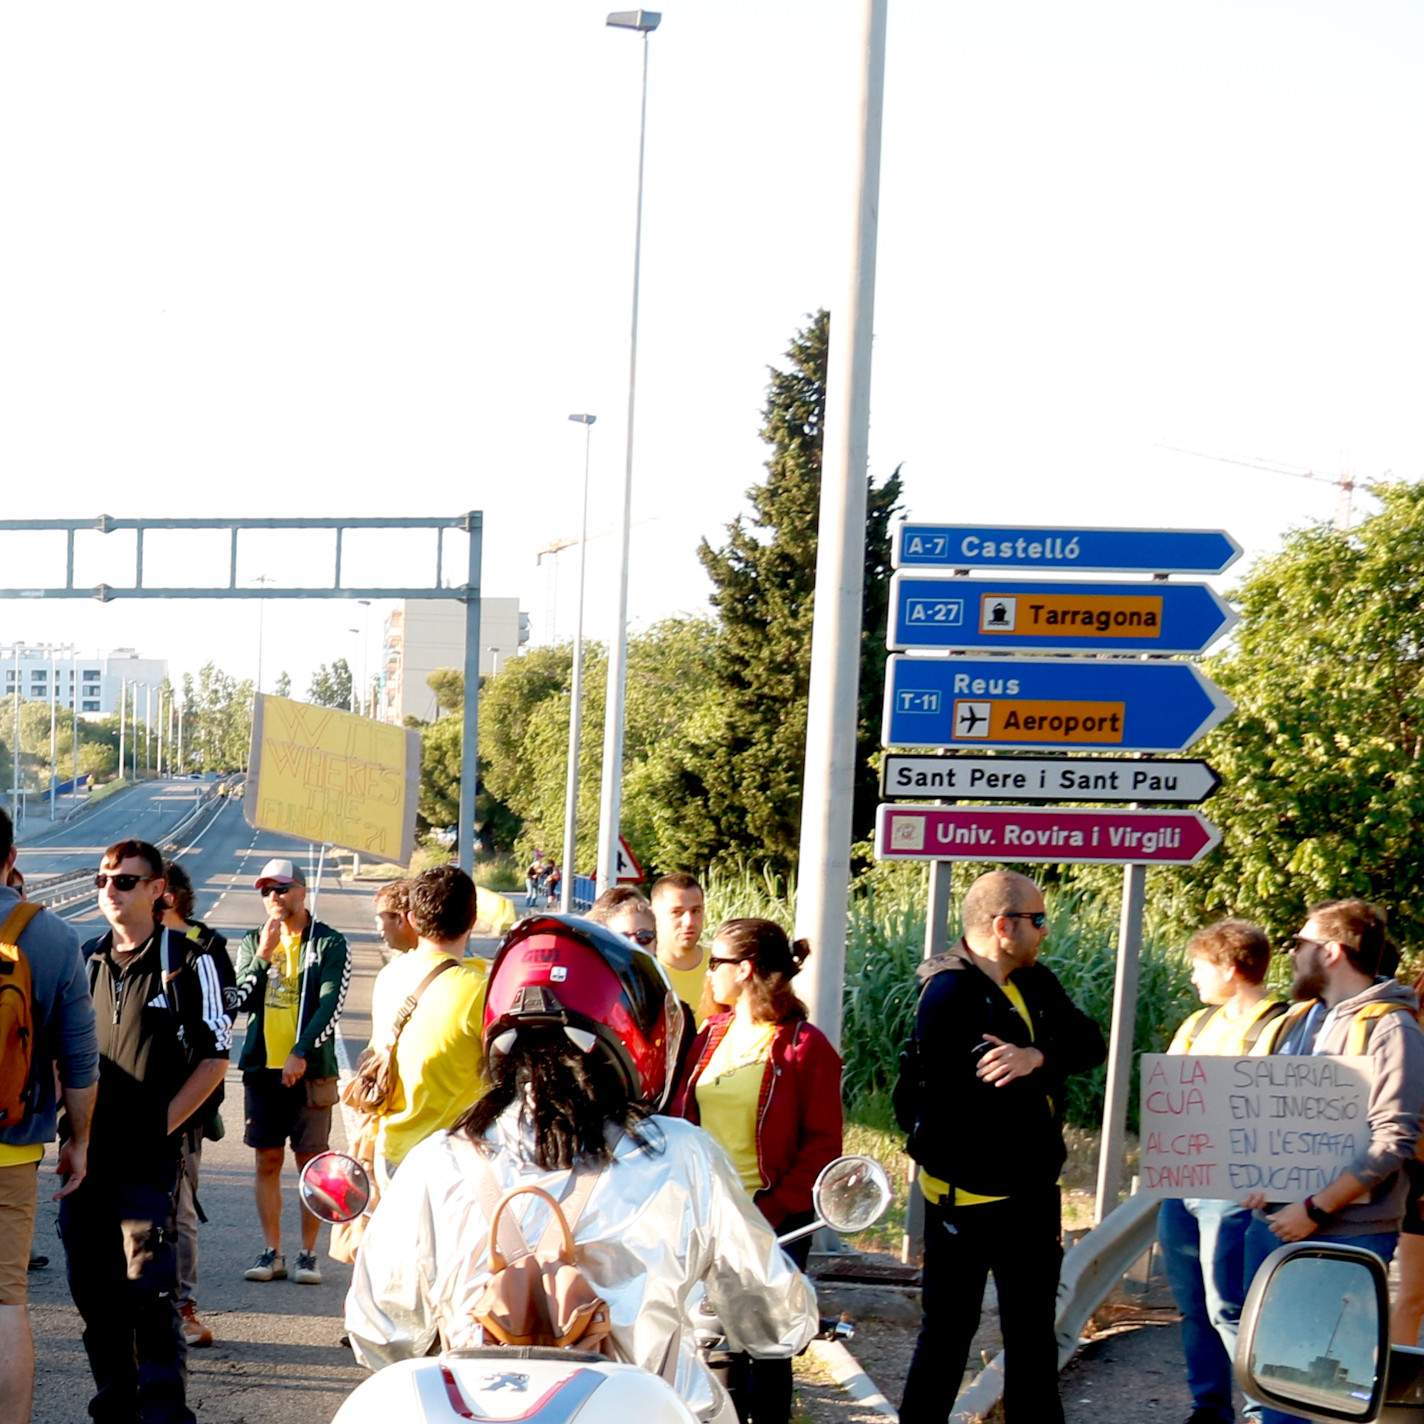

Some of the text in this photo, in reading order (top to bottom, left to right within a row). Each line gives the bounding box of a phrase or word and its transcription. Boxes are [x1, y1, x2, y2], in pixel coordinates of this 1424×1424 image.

[909, 535, 1080, 560] A-7 Castelló
[910, 603, 1157, 632] A-27 Tarragona
[954, 673, 1020, 695] Reus
[900, 692, 1120, 737] T-11 Aeroport
[897, 767, 1178, 792] Sant Pere i Sant Pau
[937, 824, 1182, 854] Univ. Rovira i Virgili
[1149, 1060, 1207, 1085] A LA
[1145, 1088, 1206, 1115] CUA
[1228, 1094, 1261, 1121] EN
[1228, 1128, 1355, 1157] EN L'ESTAFA
[1143, 1163, 1217, 1190] DAVANT
